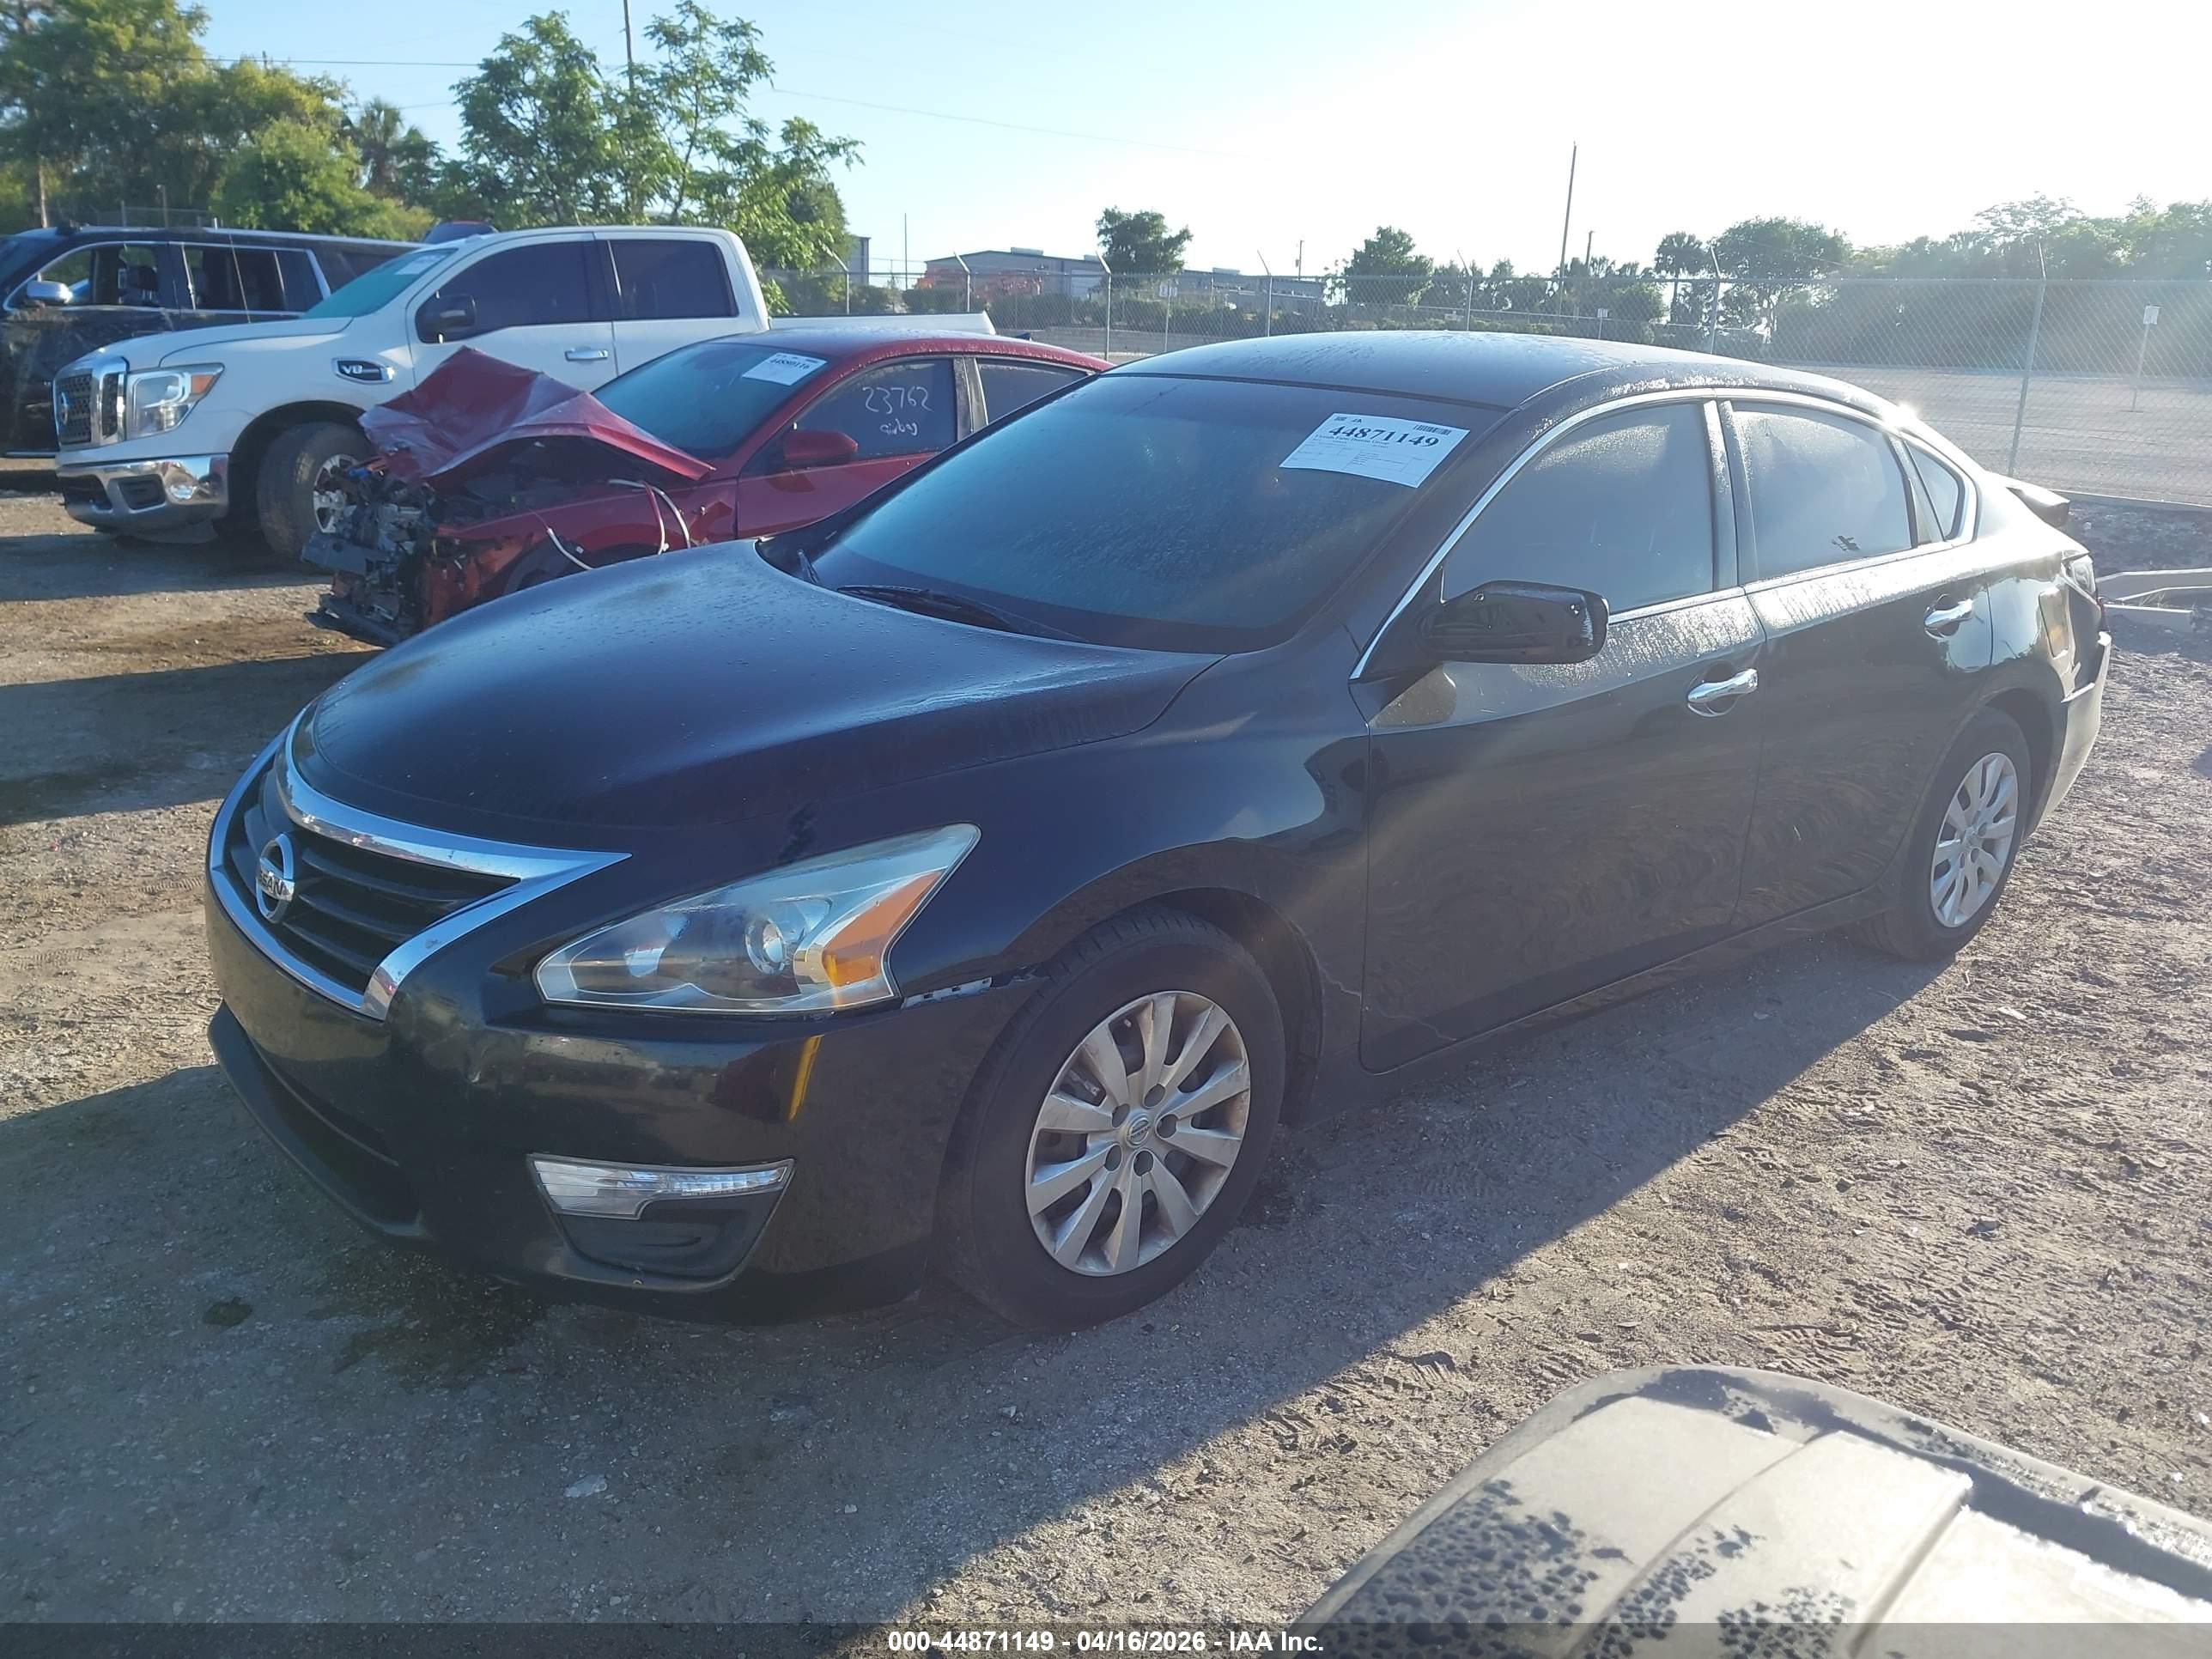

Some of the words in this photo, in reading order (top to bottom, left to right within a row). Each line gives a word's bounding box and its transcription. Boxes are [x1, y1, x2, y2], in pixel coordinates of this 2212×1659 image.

[342, 365, 362, 374] V8
[862, 386, 934, 414] 23762
[1328, 425, 1439, 447] 44871149
[258, 871, 284, 896] SSAN
